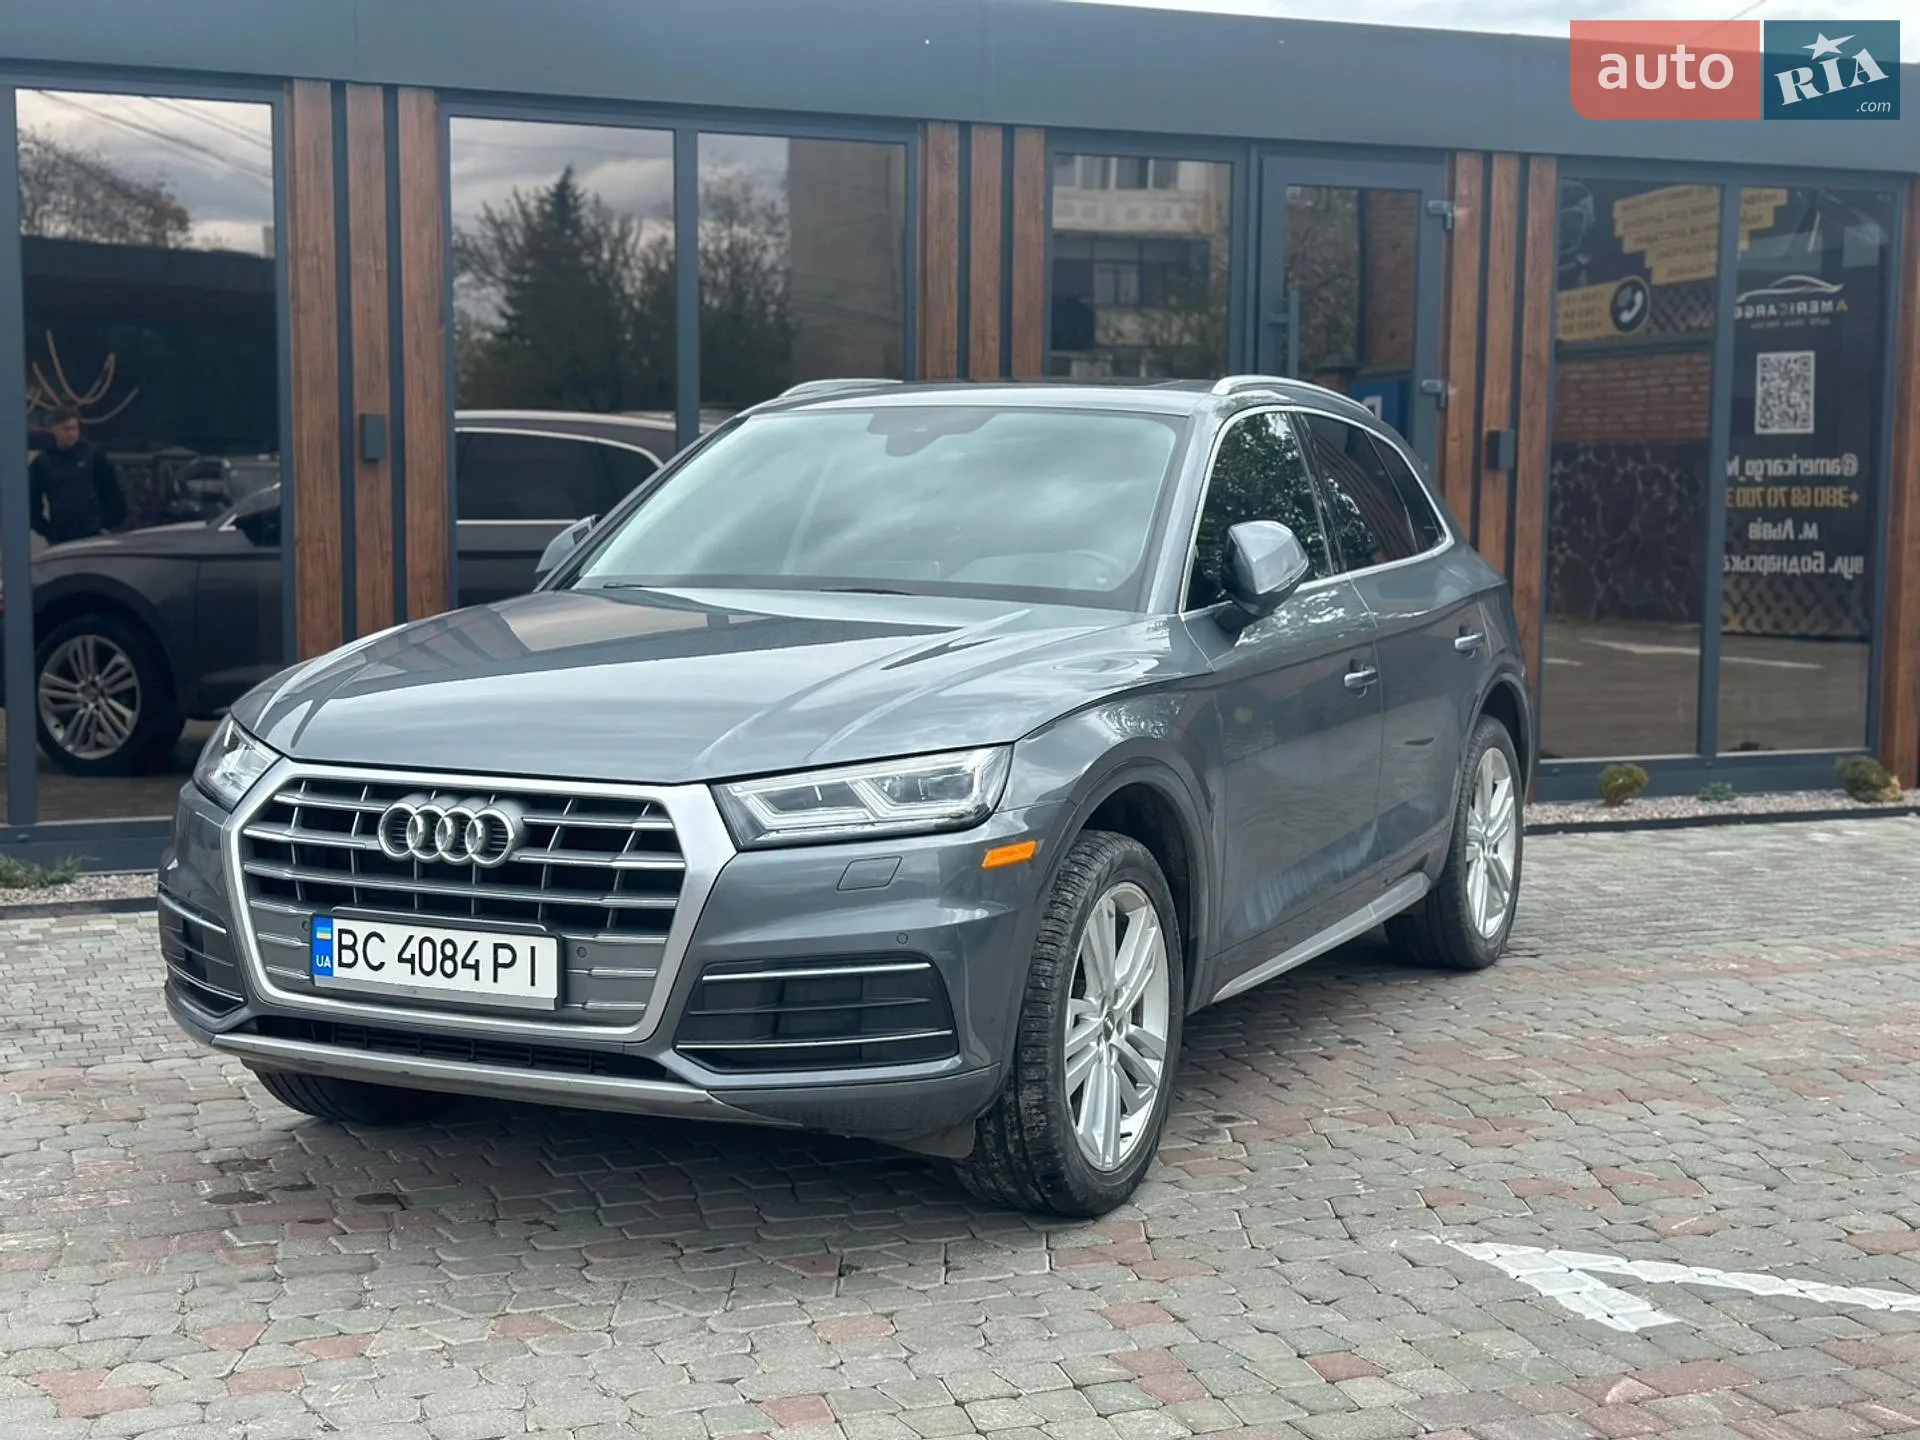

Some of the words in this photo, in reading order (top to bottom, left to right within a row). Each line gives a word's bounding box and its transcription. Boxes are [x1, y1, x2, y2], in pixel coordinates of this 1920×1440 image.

[315, 955, 332, 968] UA
[337, 928, 386, 972] BC
[397, 935, 480, 982] 4084
